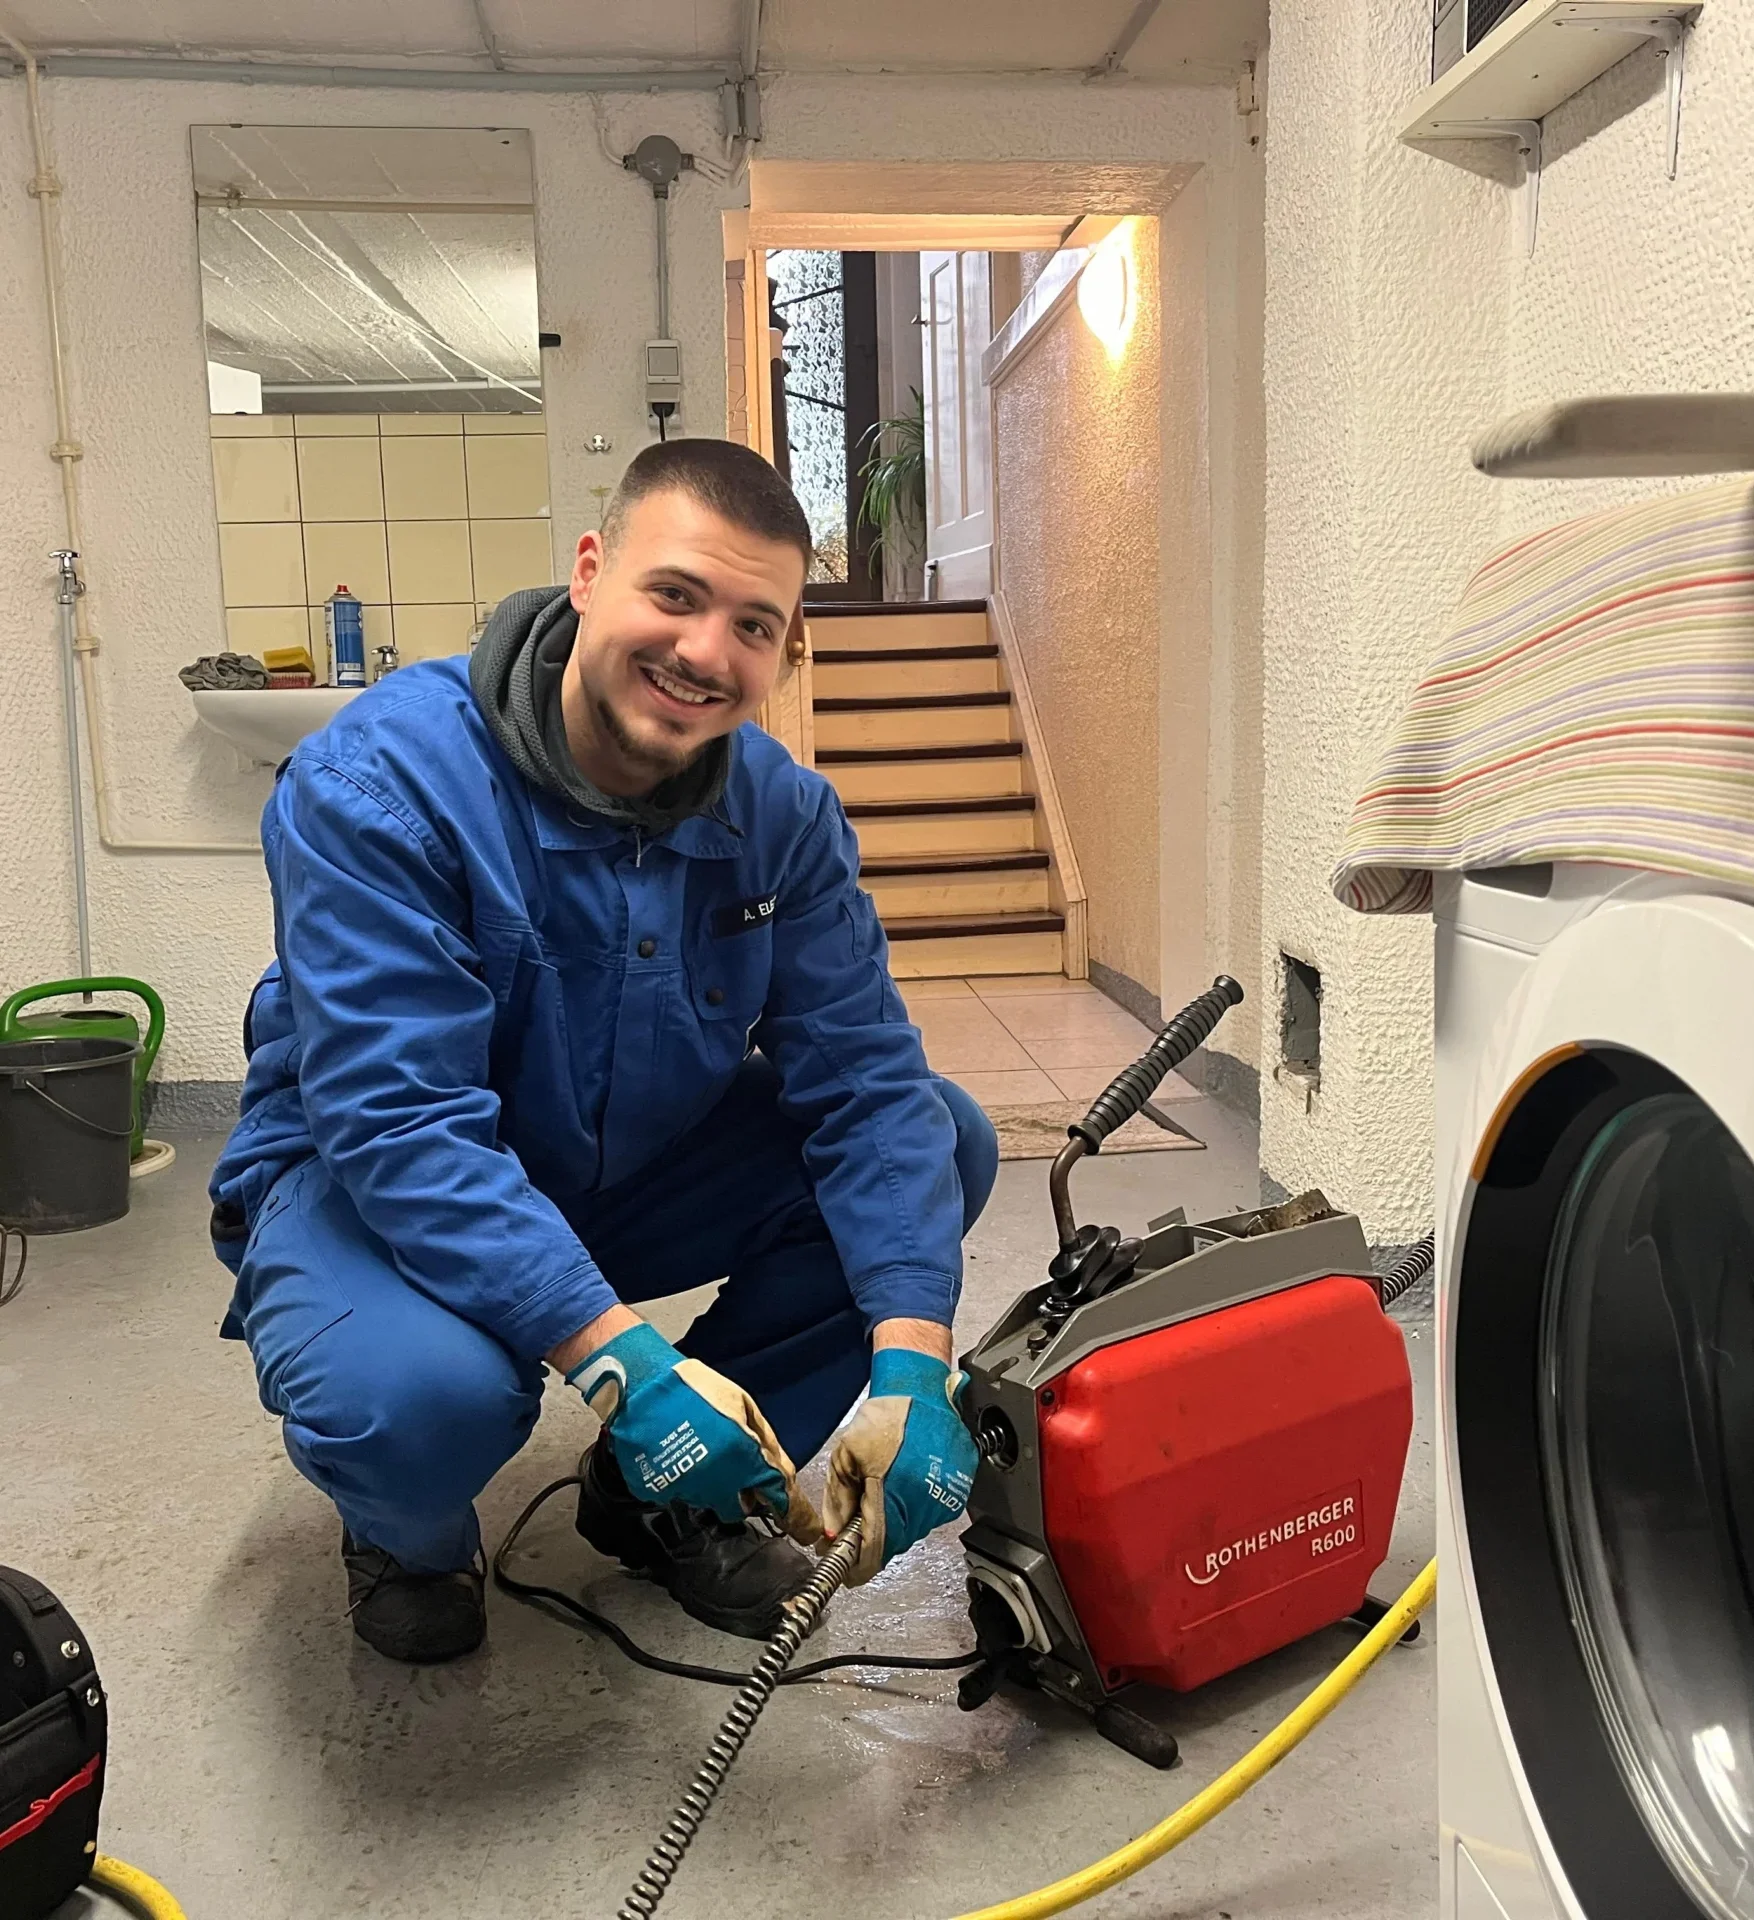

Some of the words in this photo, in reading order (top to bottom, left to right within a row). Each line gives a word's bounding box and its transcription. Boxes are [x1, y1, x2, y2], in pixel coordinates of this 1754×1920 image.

[744, 908, 756, 921] A.
[645, 1443, 709, 1493] CONEL
[925, 1478, 963, 1512] CONEL
[1204, 1497, 1355, 1574] ROTHENBERGER
[1311, 1525, 1356, 1556] R600
